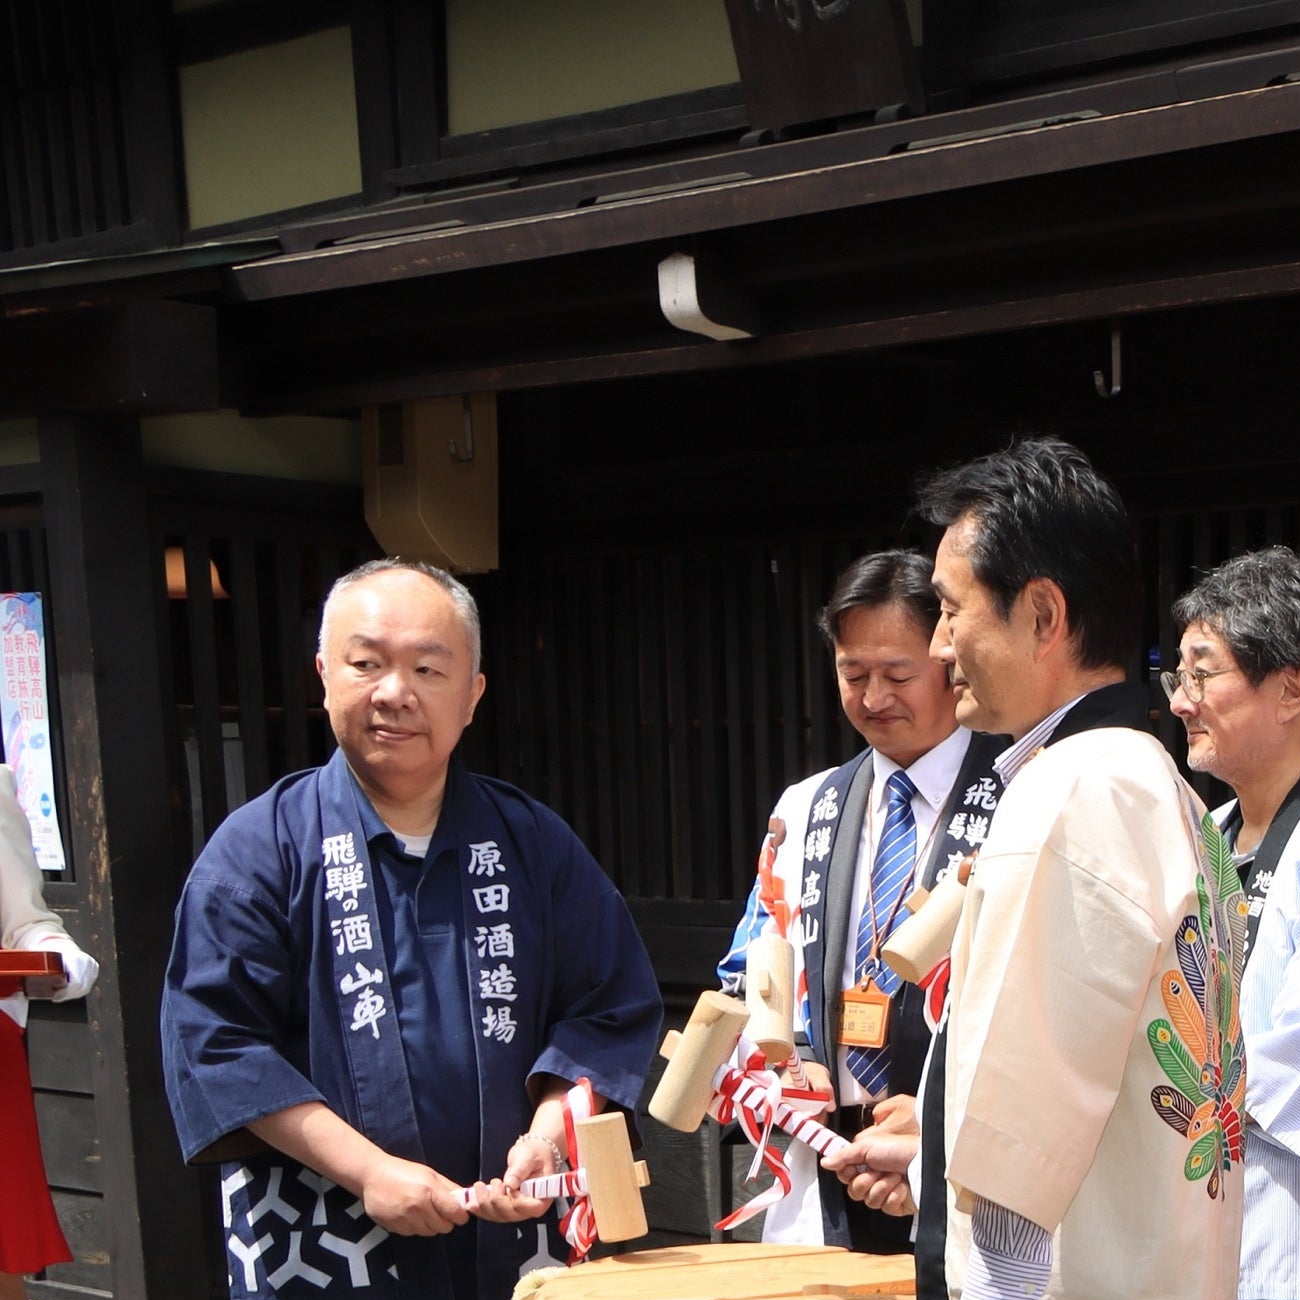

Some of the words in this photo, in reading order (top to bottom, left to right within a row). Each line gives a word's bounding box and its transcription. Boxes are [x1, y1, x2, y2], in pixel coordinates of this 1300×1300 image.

[466, 840, 518, 1044] 原田酒造場
